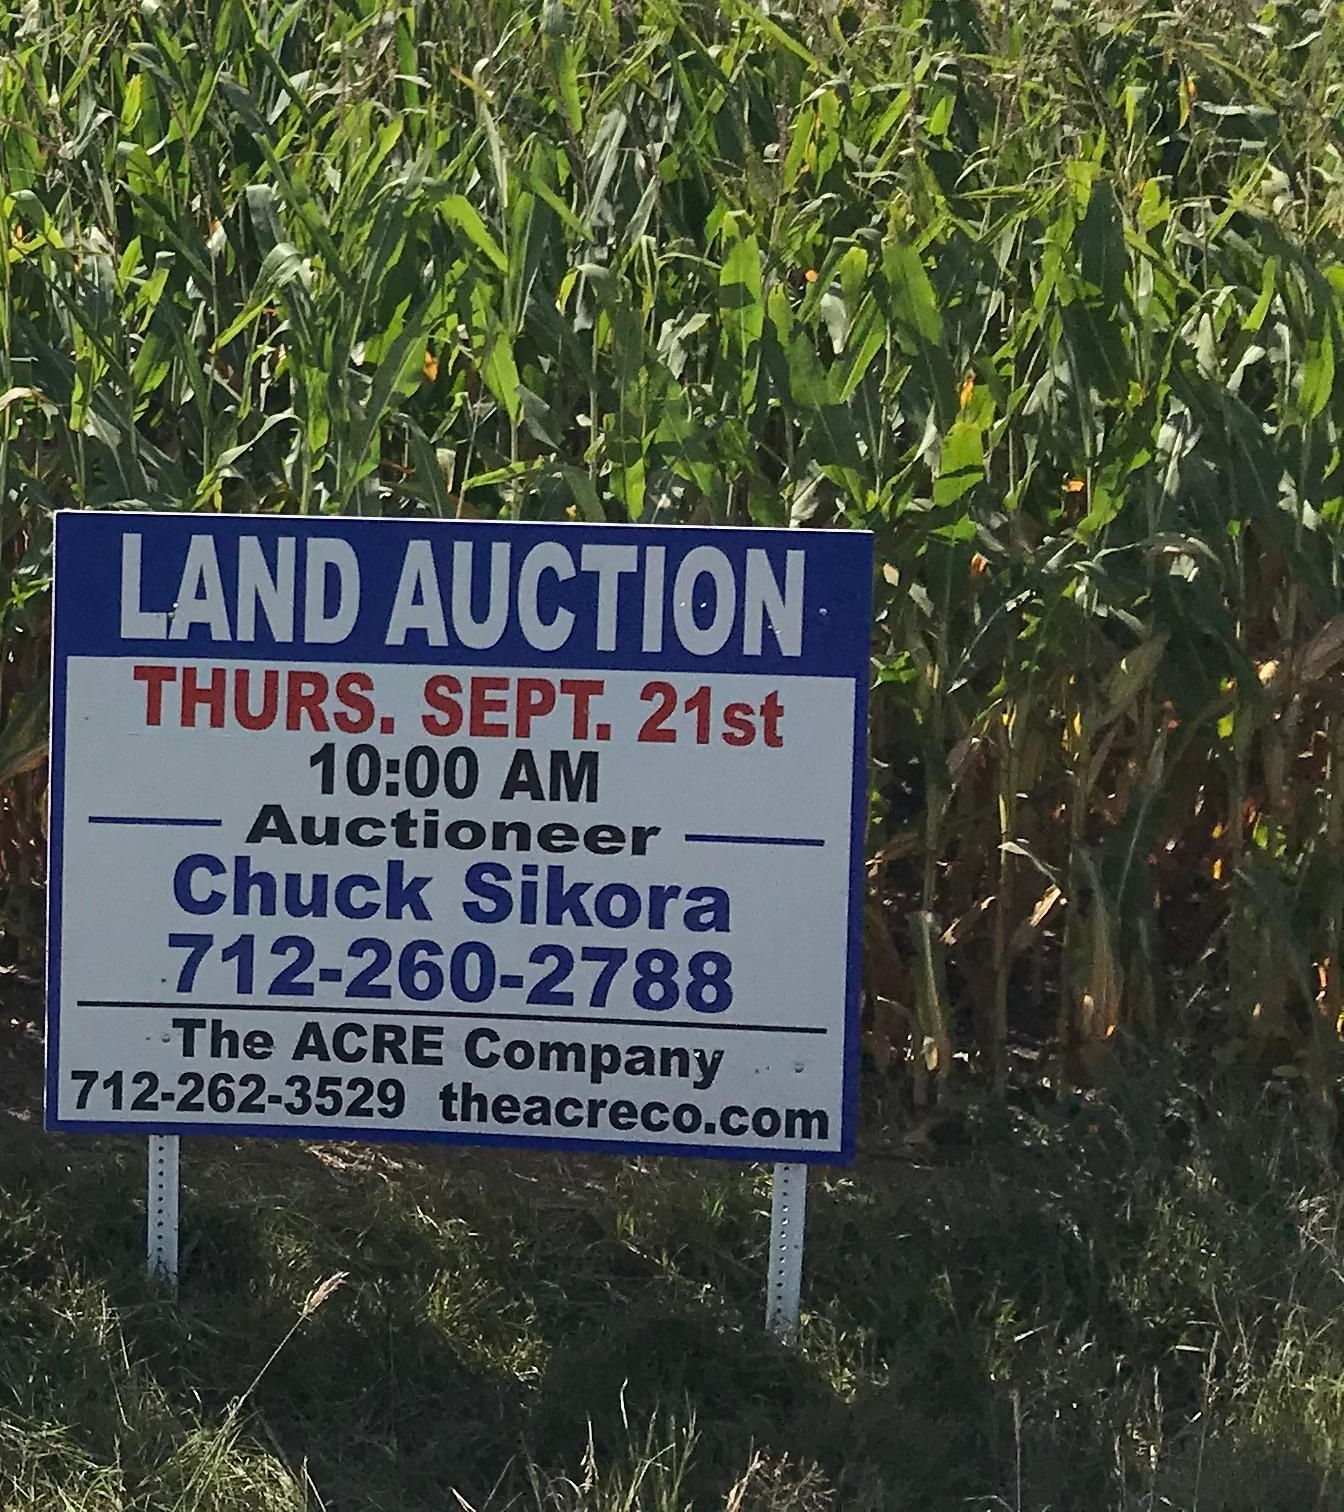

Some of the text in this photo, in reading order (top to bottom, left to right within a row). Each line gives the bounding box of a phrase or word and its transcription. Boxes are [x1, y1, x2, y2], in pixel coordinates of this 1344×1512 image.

[119, 533, 807, 658] LAND AUCTION
[133, 665, 785, 748] THURS. SEPT. 21st
[309, 743, 600, 804] 10:00 AM
[245, 804, 661, 856] Auctioneer
[172, 853, 732, 934] Chuck Sikora
[167, 934, 734, 1014] 712-260-2788
[172, 1018, 725, 1089] The ACRE Company
[70, 1071, 830, 1141] 712-262-3529 theacreco.com
